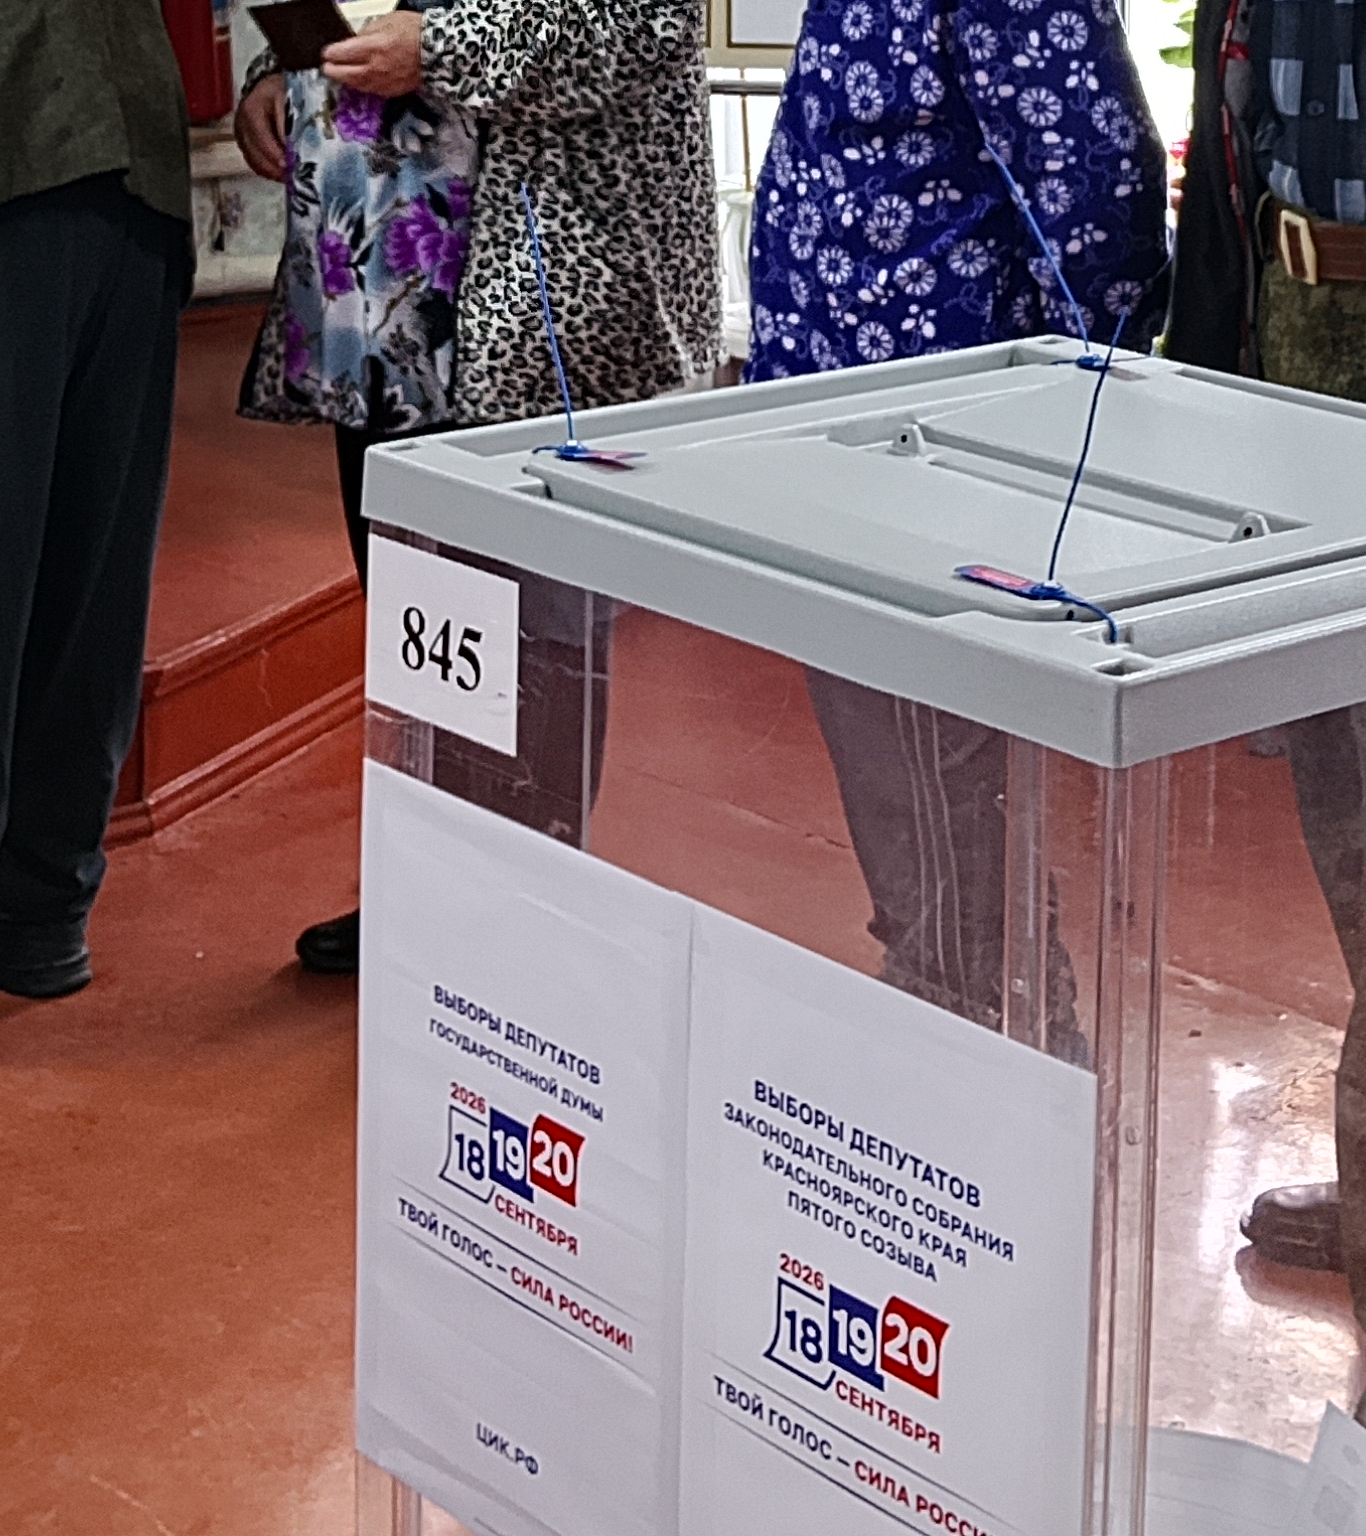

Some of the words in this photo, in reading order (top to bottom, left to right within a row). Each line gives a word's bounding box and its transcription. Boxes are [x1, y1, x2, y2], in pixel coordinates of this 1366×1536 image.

[402, 607, 483, 691] 845
[429, 1019, 558, 1098] ГОСУДАРСТВЕННОЙ
[561, 1087, 603, 1122] ДУМЫ
[434, 985, 502, 1035] ВЫБОРЫ
[505, 1022, 601, 1084] ДЕПУТАТОВ
[450, 1082, 486, 1114] 2026
[455, 1133, 484, 1181] 18
[492, 1130, 526, 1180] 19
[532, 1130, 575, 1187] 20
[724, 1102, 908, 1208] ЗАКОНОДАТЕЛЬНОГО
[912, 1197, 1014, 1262] СОБРАНИЯ
[754, 1079, 844, 1142] ВЫБОРЫ
[849, 1128, 981, 1208] ДЕПУТАТОВ
[495, 1193, 579, 1256] СЕНТЯБРЯ
[763, 1149, 914, 1240] КРАСНОЯРСКОГО
[919, 1228, 967, 1268] КРАЯ
[788, 1190, 856, 1239] ПЯТОГО
[861, 1228, 938, 1283] СОЗЫВА
[398, 1197, 438, 1236] ТВОЙ
[442, 1227, 493, 1268] ГОЛОС
[511, 1266, 554, 1307] СИЛА
[559, 1294, 633, 1354] РОССИИ!
[779, 1253, 825, 1291] 2026
[784, 1309, 823, 1364] 18
[833, 1308, 875, 1366] 19
[883, 1313, 937, 1377] 20
[477, 1422, 539, 1475] ЦИК.РФ
[714, 1375, 763, 1421] ТВОЙ
[768, 1408, 832, 1461] ГОЛОС
[854, 1460, 910, 1508] СИЛА
[835, 1379, 941, 1454] СЕНТЯБРЯ
